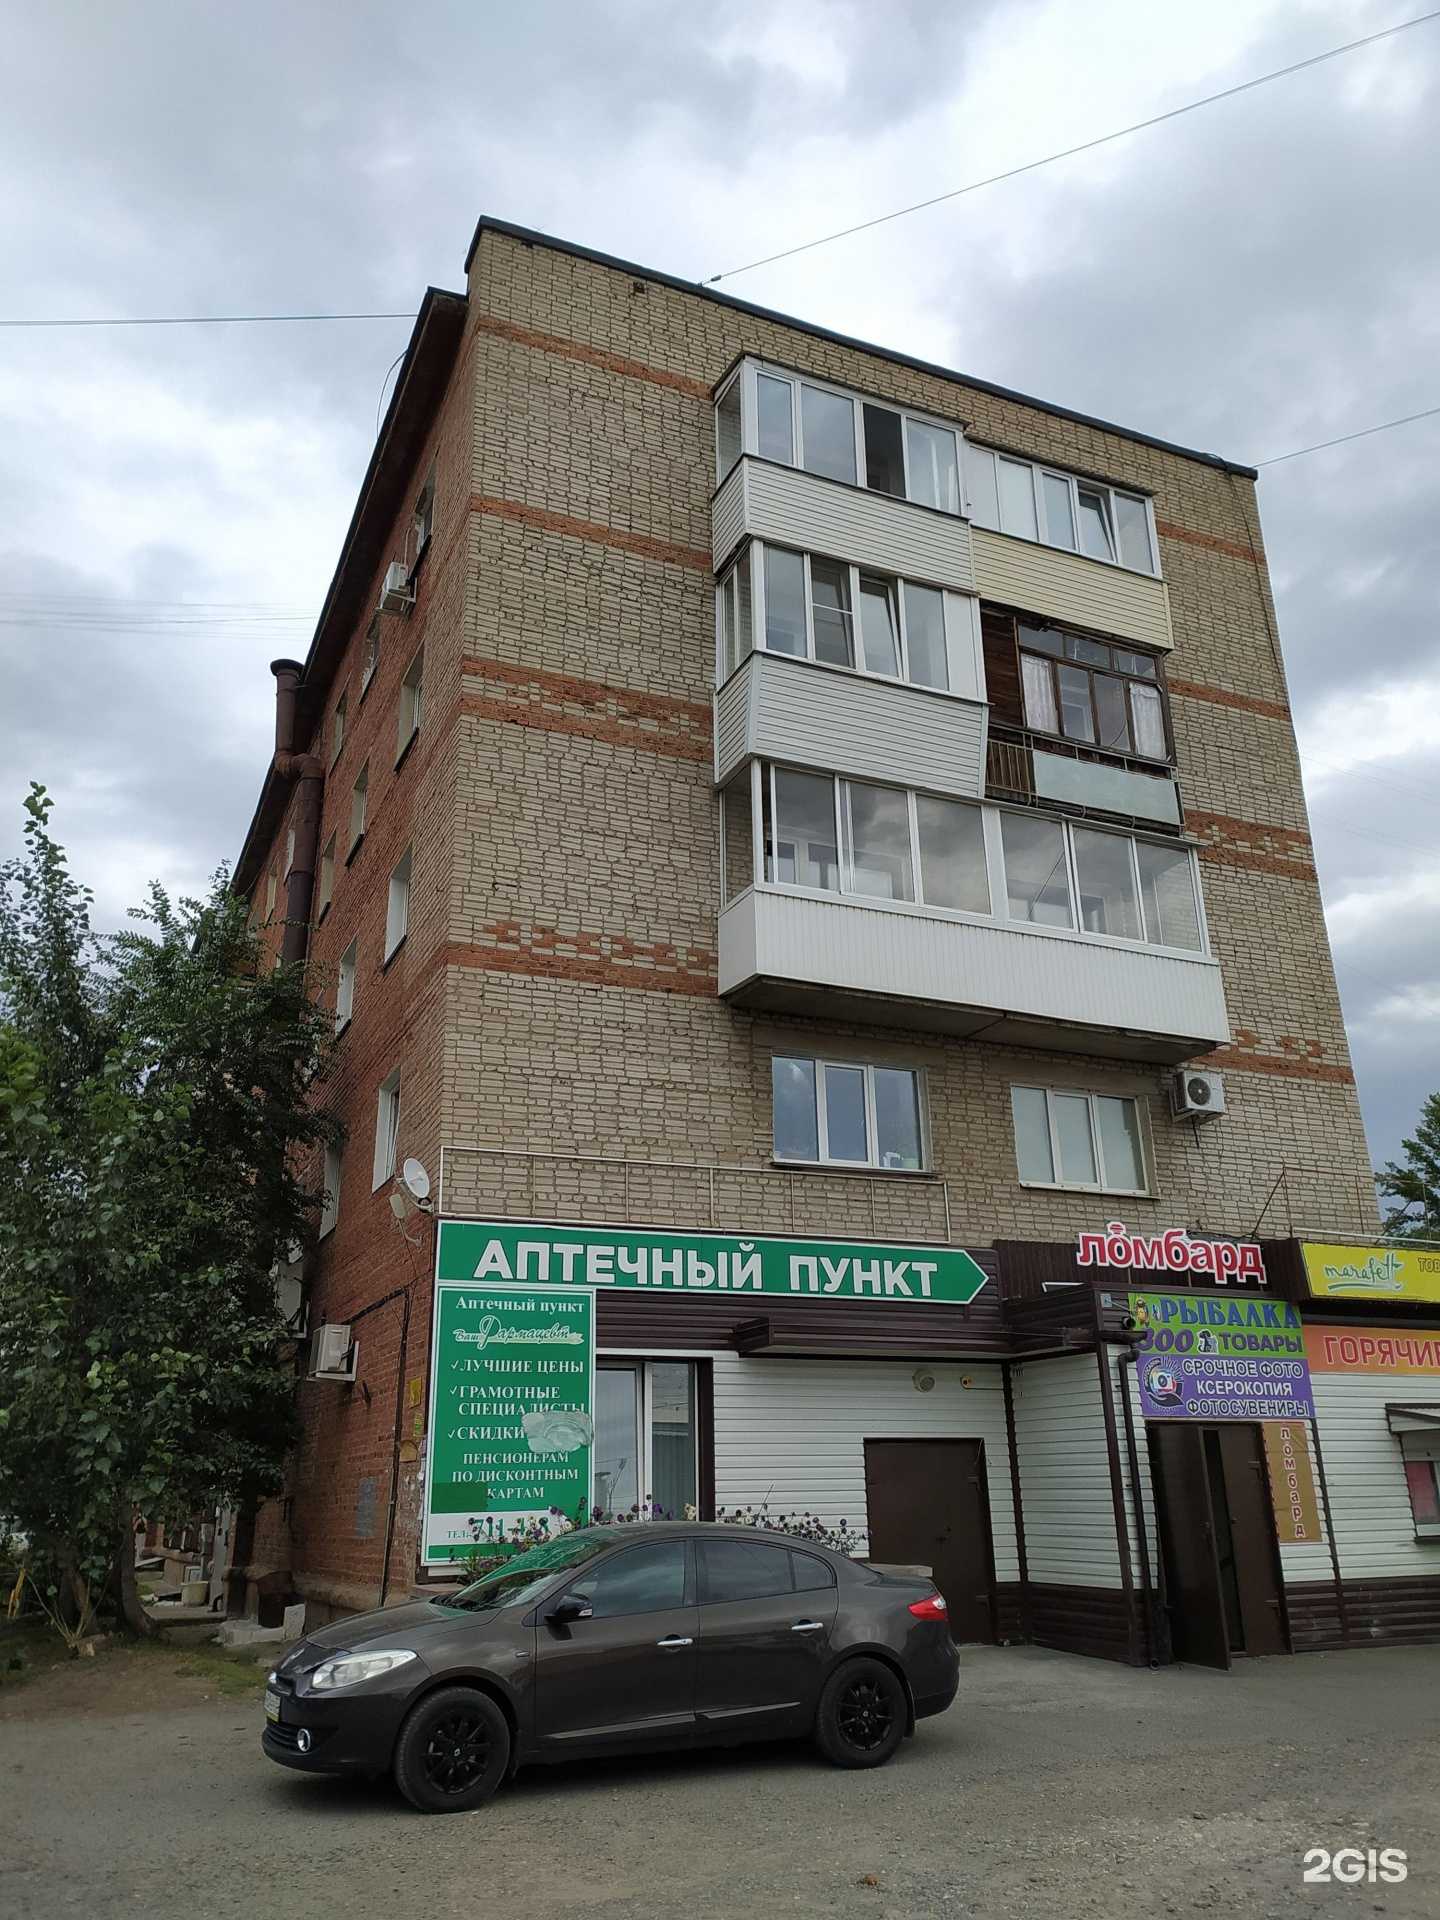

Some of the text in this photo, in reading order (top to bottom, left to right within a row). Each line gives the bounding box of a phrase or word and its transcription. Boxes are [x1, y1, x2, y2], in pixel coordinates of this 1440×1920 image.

[473, 1239, 938, 1297] АПТЕЧНЫЙ ПУНКТ
[456, 1296, 585, 1315] Аптечный пункт
[1158, 1299, 1302, 1328] РЫБАЛКА
[477, 1315, 570, 1350] Фармацевт
[1219, 1329, 1303, 1352] ТОВАРЫ
[460, 1359, 584, 1375] ЛУЧШИЕ ЦЕНЫ
[1183, 1359, 1304, 1378] СРОЧНОЕ ФОТО
[459, 1386, 560, 1398] ГРАМОТНЫЕ
[1197, 1380, 1293, 1395] КСЕРОКОПИЯ
[1187, 1399, 1310, 1416] ФОТОСУВЕНИРЫ
[457, 1427, 524, 1440] СКИДКИ
[463, 1452, 569, 1464] ПЕНСИОНЕРАМ
[452, 1470, 578, 1482] ПО ДИСКОНТНЫМ
[1281, 1428, 1305, 1538] ломбард
[487, 1488, 544, 1499] КАРТАМ
